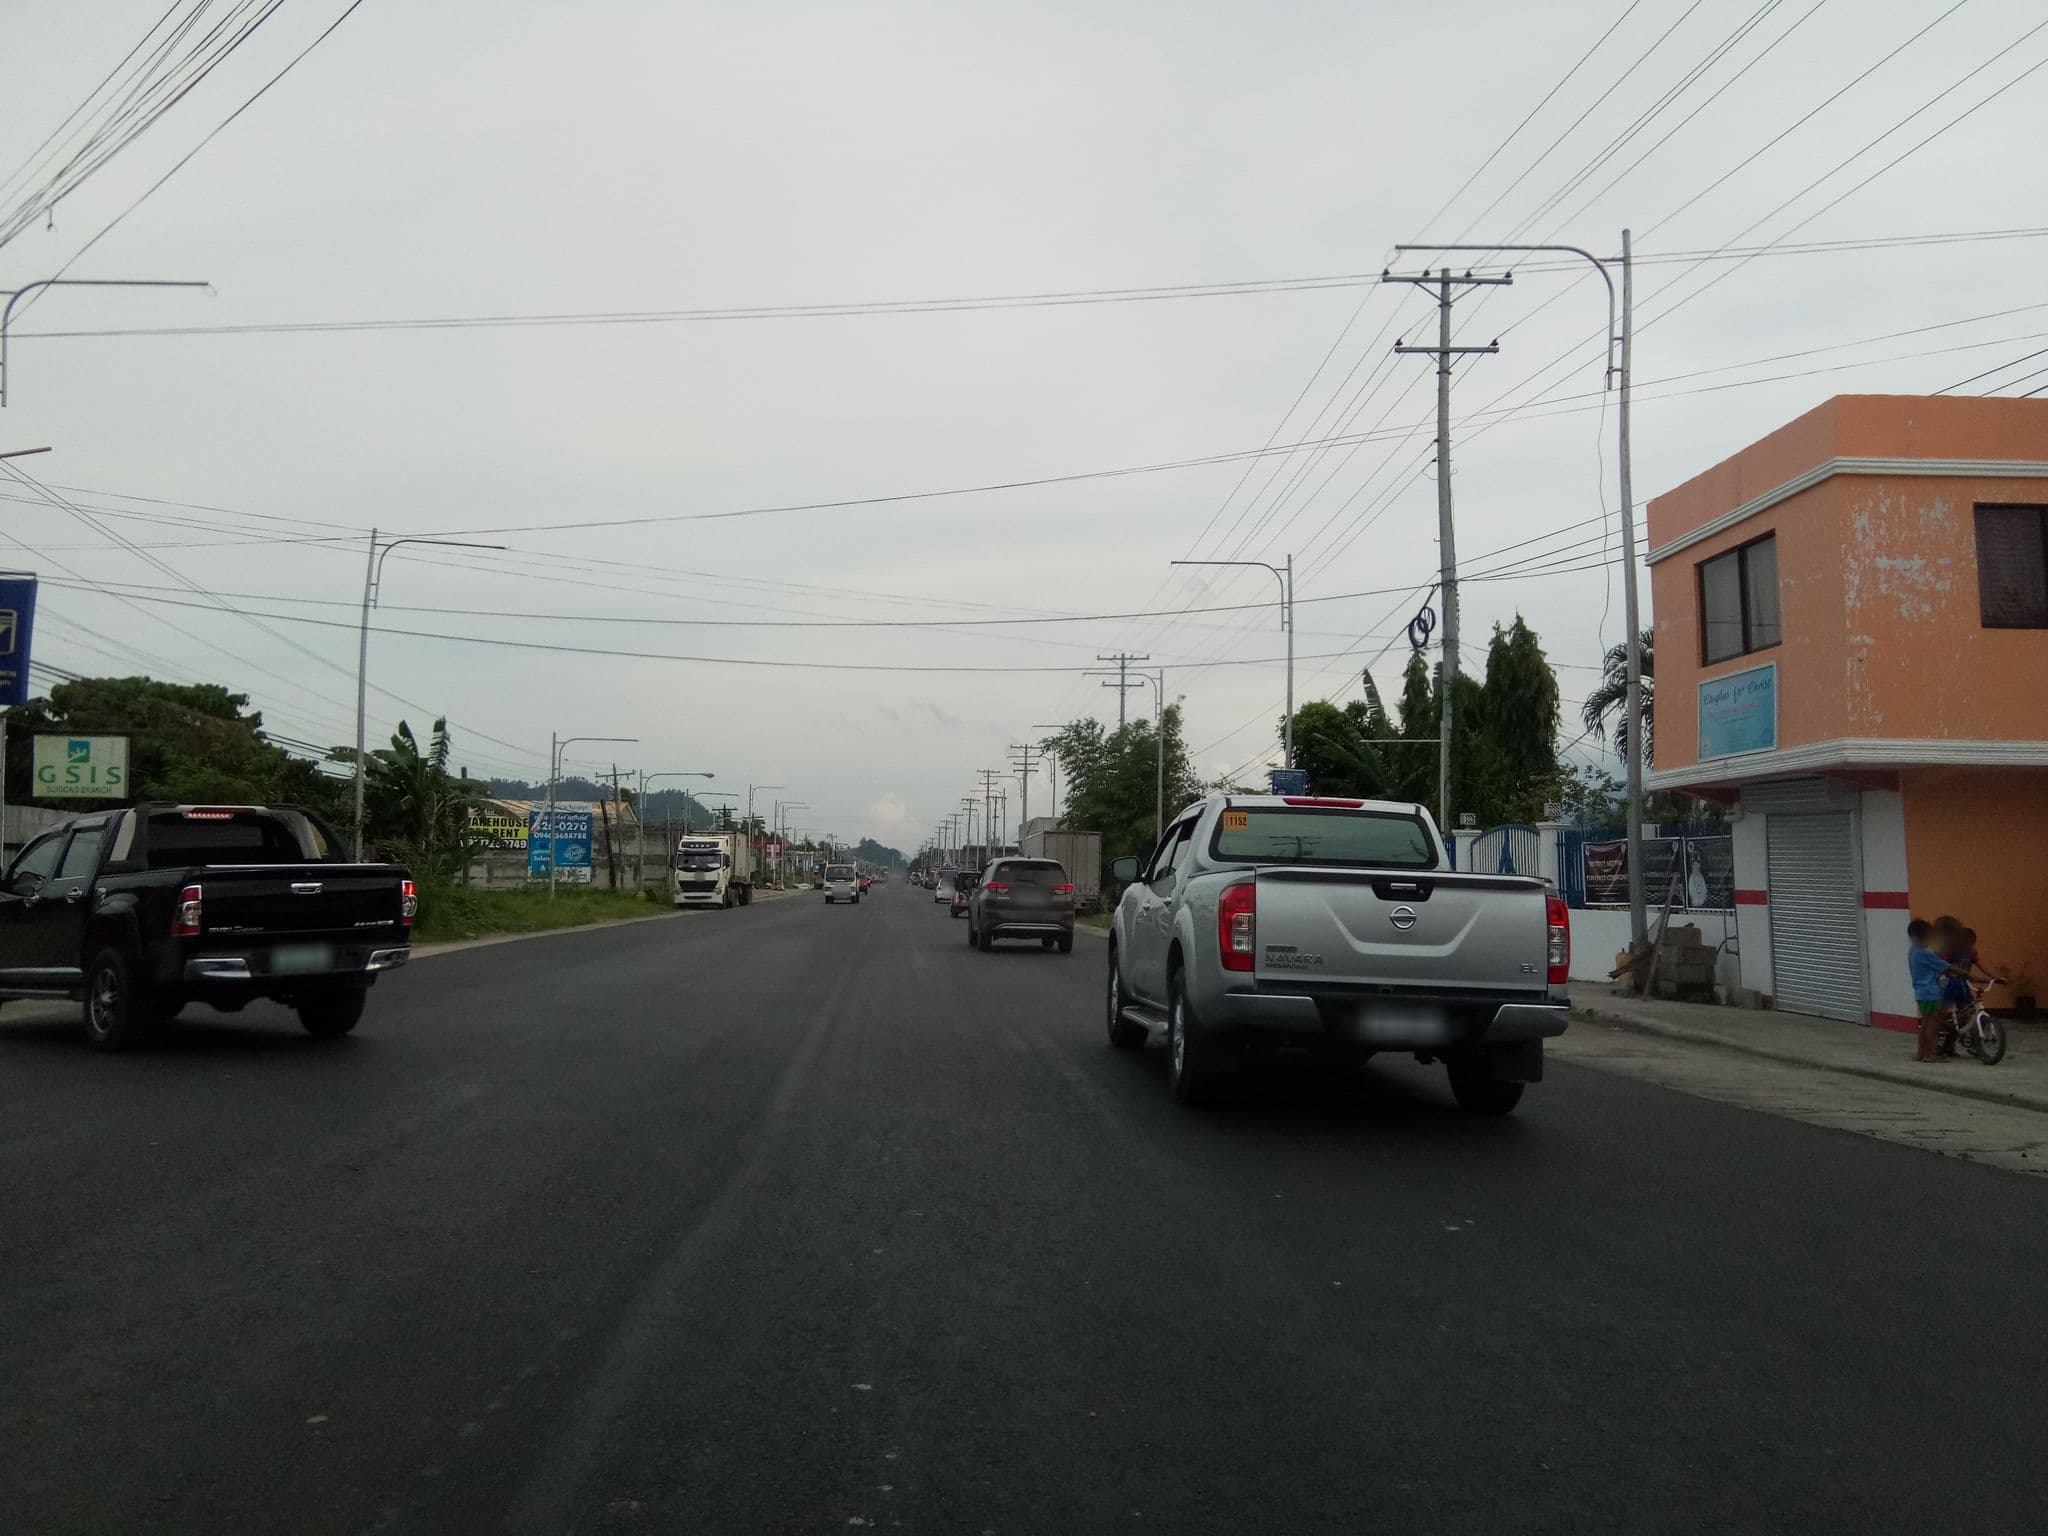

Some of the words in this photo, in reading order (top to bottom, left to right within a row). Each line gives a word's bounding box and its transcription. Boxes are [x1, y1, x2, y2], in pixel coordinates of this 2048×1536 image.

[1733, 685, 1745, 704] for
[38, 765, 121, 784] GSIS
[81, 785, 112, 793] BRANCH
[1230, 816, 1247, 826] 1152
[1265, 952, 1322, 964] NAVARA
